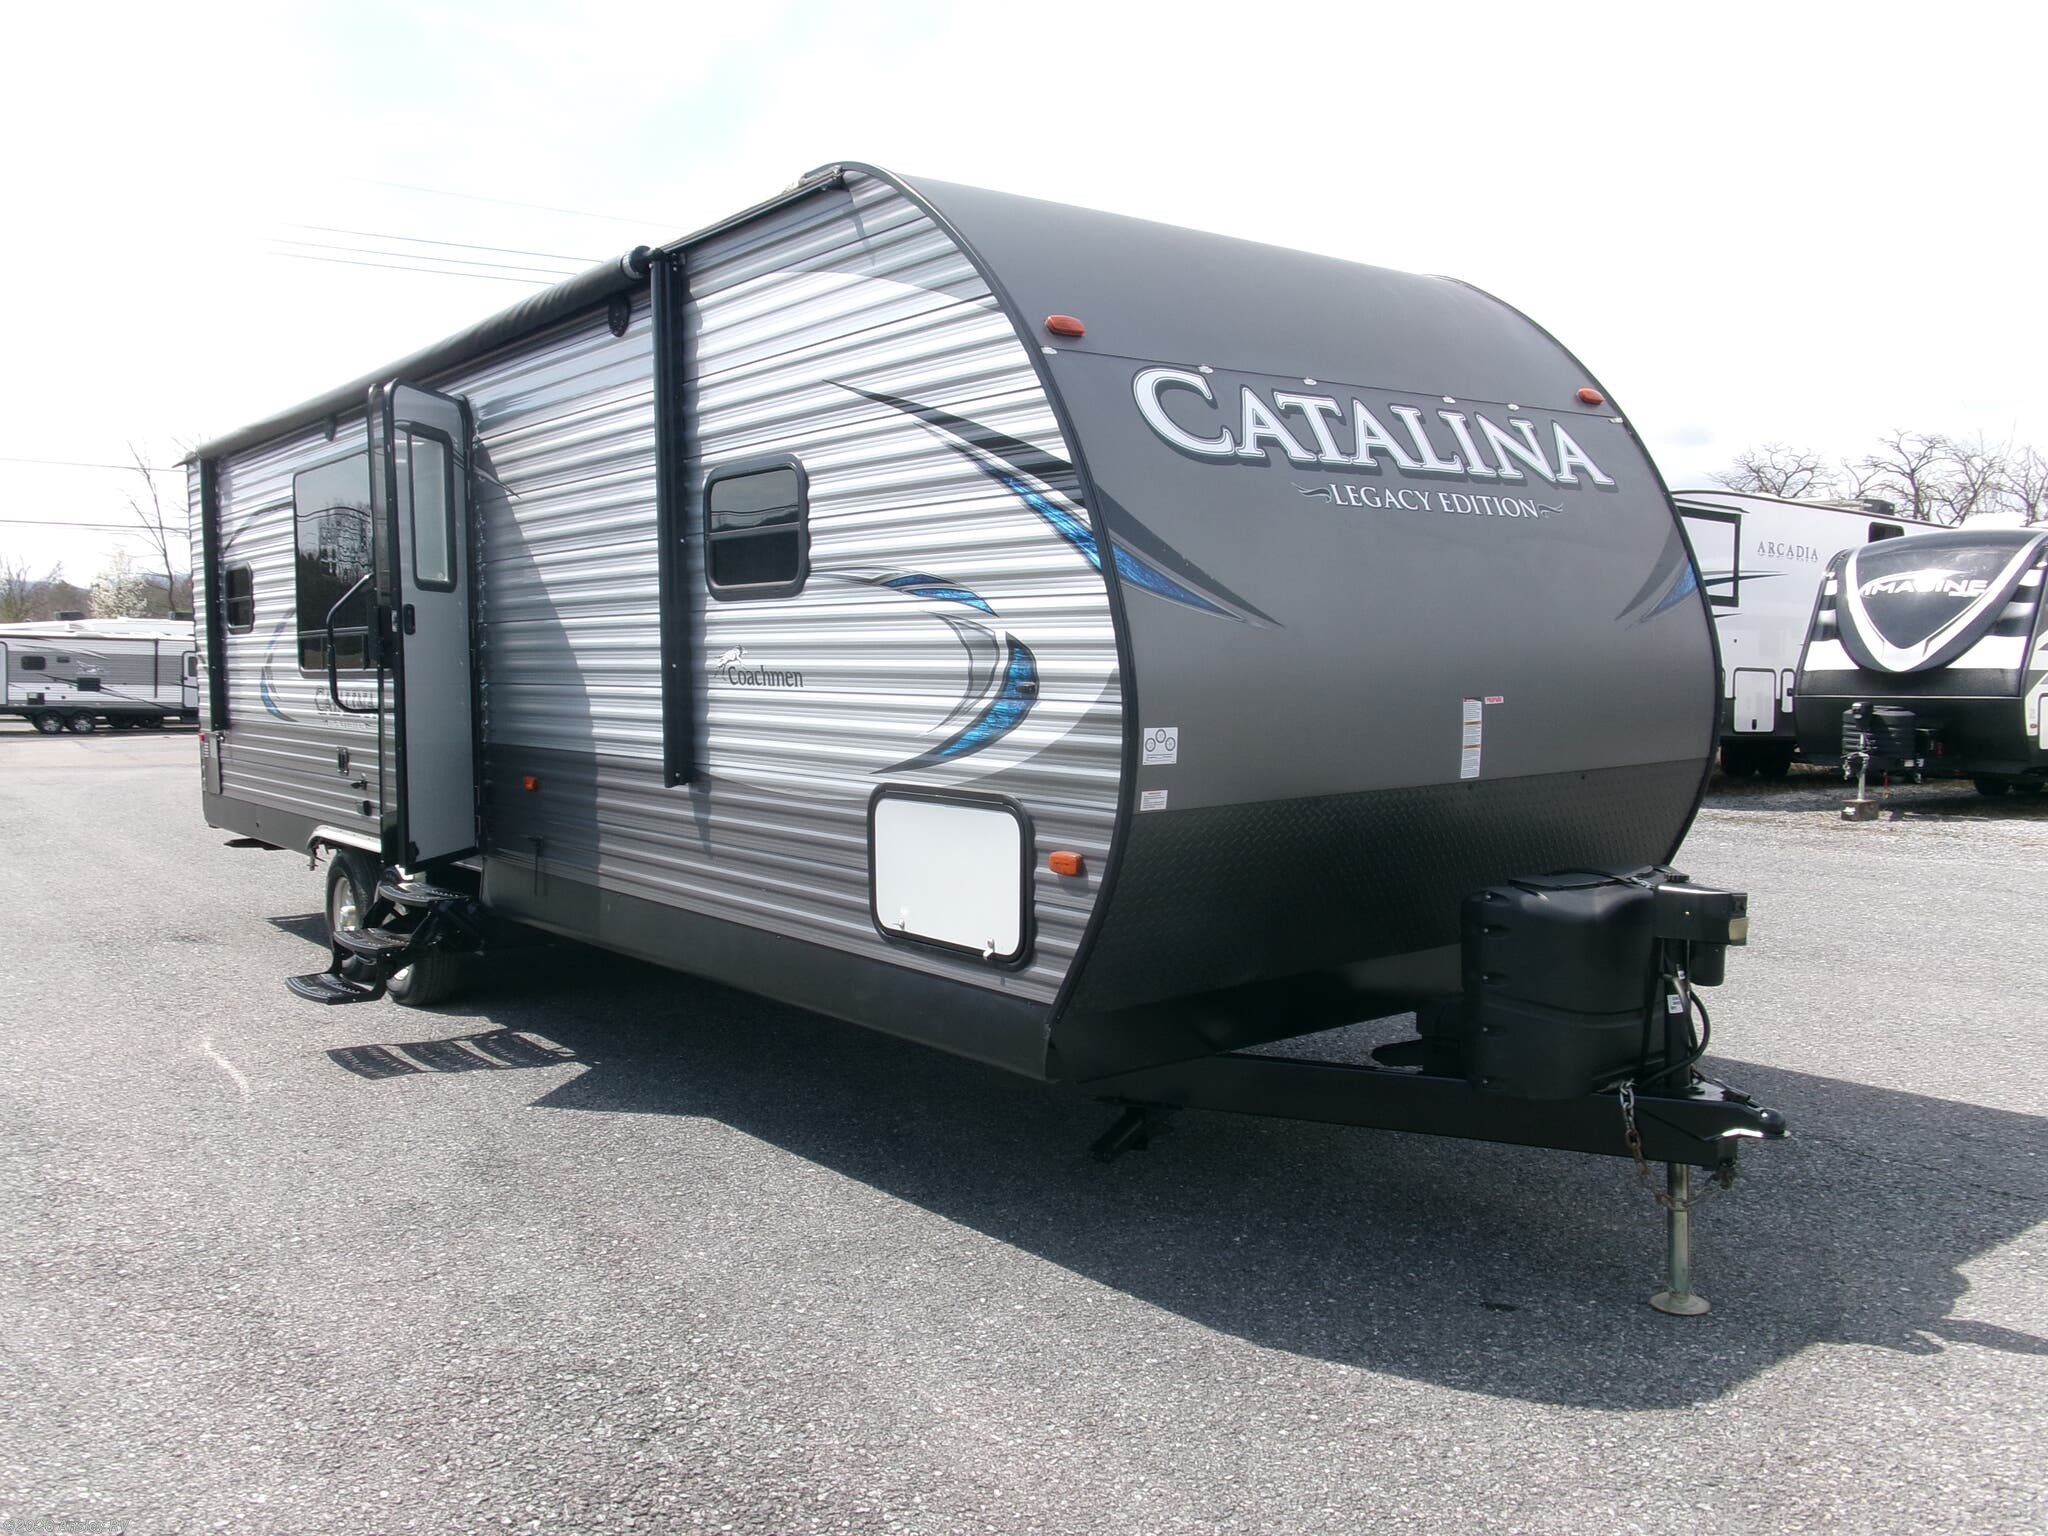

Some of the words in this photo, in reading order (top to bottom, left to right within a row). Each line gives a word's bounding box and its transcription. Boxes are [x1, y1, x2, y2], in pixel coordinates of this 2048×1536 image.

[1133, 366, 1615, 487] CATALINA
[1330, 483, 1432, 511] LEGACY
[1437, 492, 1540, 518] EDITION
[1757, 541, 1818, 560] ARCADIA
[728, 665, 804, 688] Coachmen
